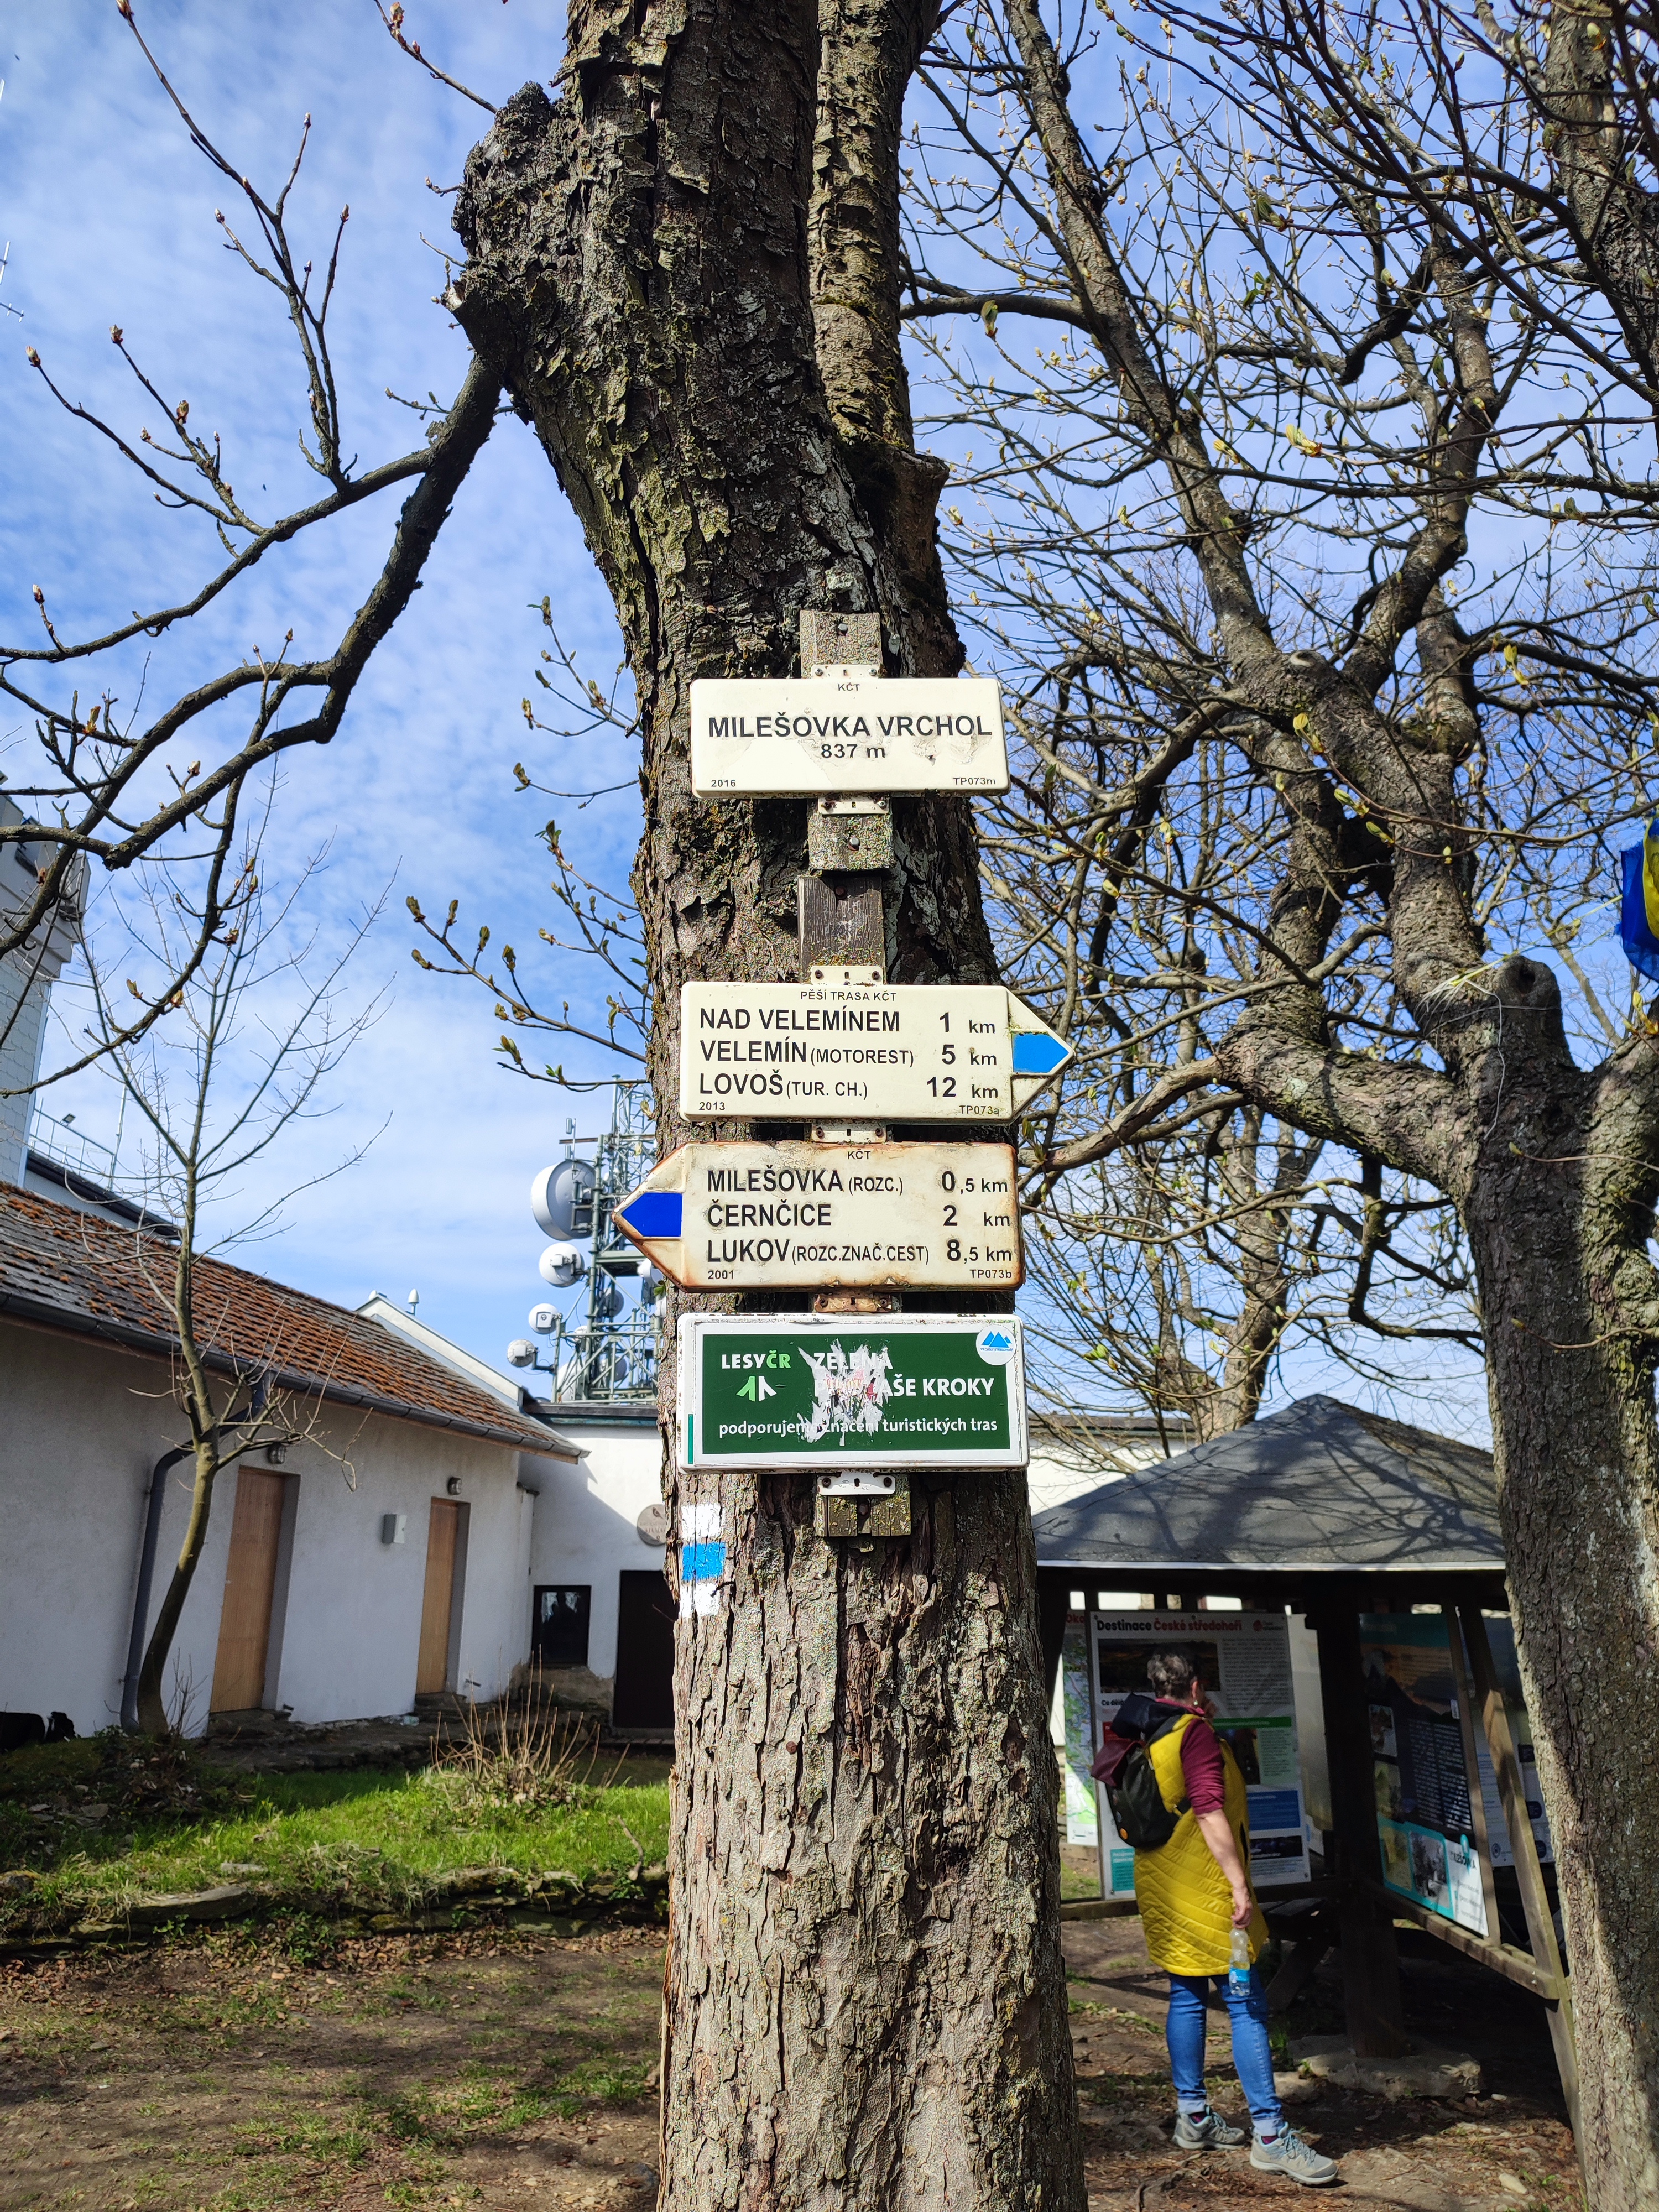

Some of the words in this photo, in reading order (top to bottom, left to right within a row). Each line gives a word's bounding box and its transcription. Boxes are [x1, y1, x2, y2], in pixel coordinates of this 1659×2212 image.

[838, 683, 859, 691] KČT
[709, 712, 870, 738] MILEŠOVKA
[877, 716, 992, 737] VRCHOL
[821, 744, 858, 759] 837
[867, 747, 885, 758] m
[711, 779, 736, 787] 2016
[953, 777, 996, 785] TP073m
[800, 989, 827, 1000] PĚŠÍ
[831, 992, 870, 1001] TRASA
[873, 990, 897, 1001] KČT
[700, 1008, 750, 1029] NAD
[758, 1005, 900, 1032] VELEMÍNEM
[940, 1012, 950, 1032] 1
[969, 1019, 995, 1034] km
[700, 1036, 806, 1063] VELEMÍN
[811, 1048, 914, 1068] (MOTOREST)
[941, 1044, 956, 1065] 5
[970, 1051, 997, 1066] km
[700, 1068, 783, 1095] LOVOŠ
[835, 1082, 868, 1100] CH.)
[927, 1076, 957, 1098] 12
[972, 1084, 998, 1099] km
[699, 1102, 726, 1111] 2013
[958, 1105, 999, 1115] TP073a
[847, 1149, 871, 1160] KČT
[708, 1165, 844, 1192] MILEŠOVKA
[848, 1177, 903, 1196] (ROZC.)
[981, 1178, 1008, 1192] km
[707, 1198, 832, 1227] ČERNČICE
[943, 1204, 958, 1227] 2
[984, 1212, 1010, 1227] km
[708, 1239, 790, 1262] LUKOV
[986, 1246, 1012, 1262] km
[707, 1270, 734, 1280] 2001
[969, 1269, 1012, 1279] TP073b
[922, 1378, 995, 1396] KROKY
[884, 1418, 967, 1435] turistických
[971, 1418, 997, 1431] tras
[1097, 1619, 1151, 1631] Destinace
[1154, 1618, 1186, 1631] České
